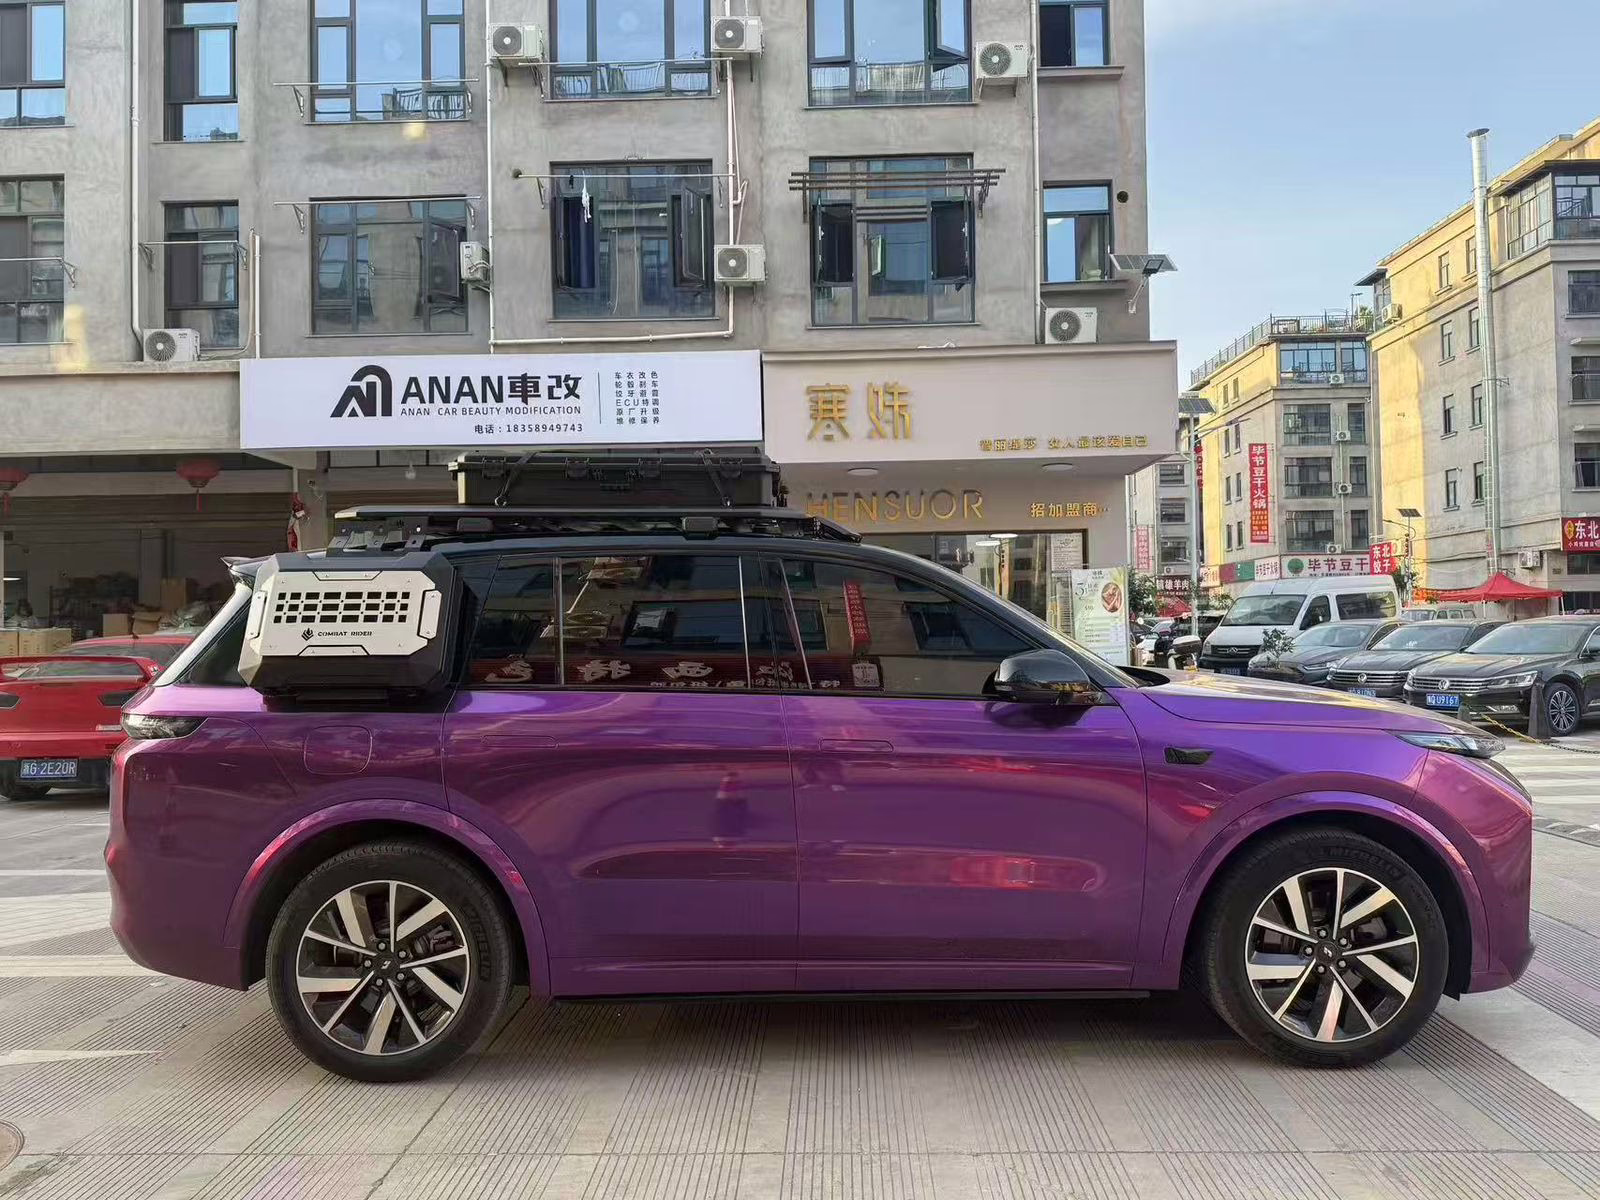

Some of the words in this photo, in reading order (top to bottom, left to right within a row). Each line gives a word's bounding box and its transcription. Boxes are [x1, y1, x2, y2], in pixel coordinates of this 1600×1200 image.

[400, 407, 430, 416] ANAN
[437, 407, 458, 416] CAR
[461, 406, 501, 416] BEAUTY
[505, 405, 581, 415] MODIFICATION
[1252, 445, 1266, 509] 毕节豆干火锅
[807, 489, 983, 523] HENSUOR
[1574, 520, 1599, 539] 东北
[1372, 544, 1391, 558] 东北
[1308, 558, 1368, 572] 毕节豆干
[1373, 559, 1391, 573] 饺子
